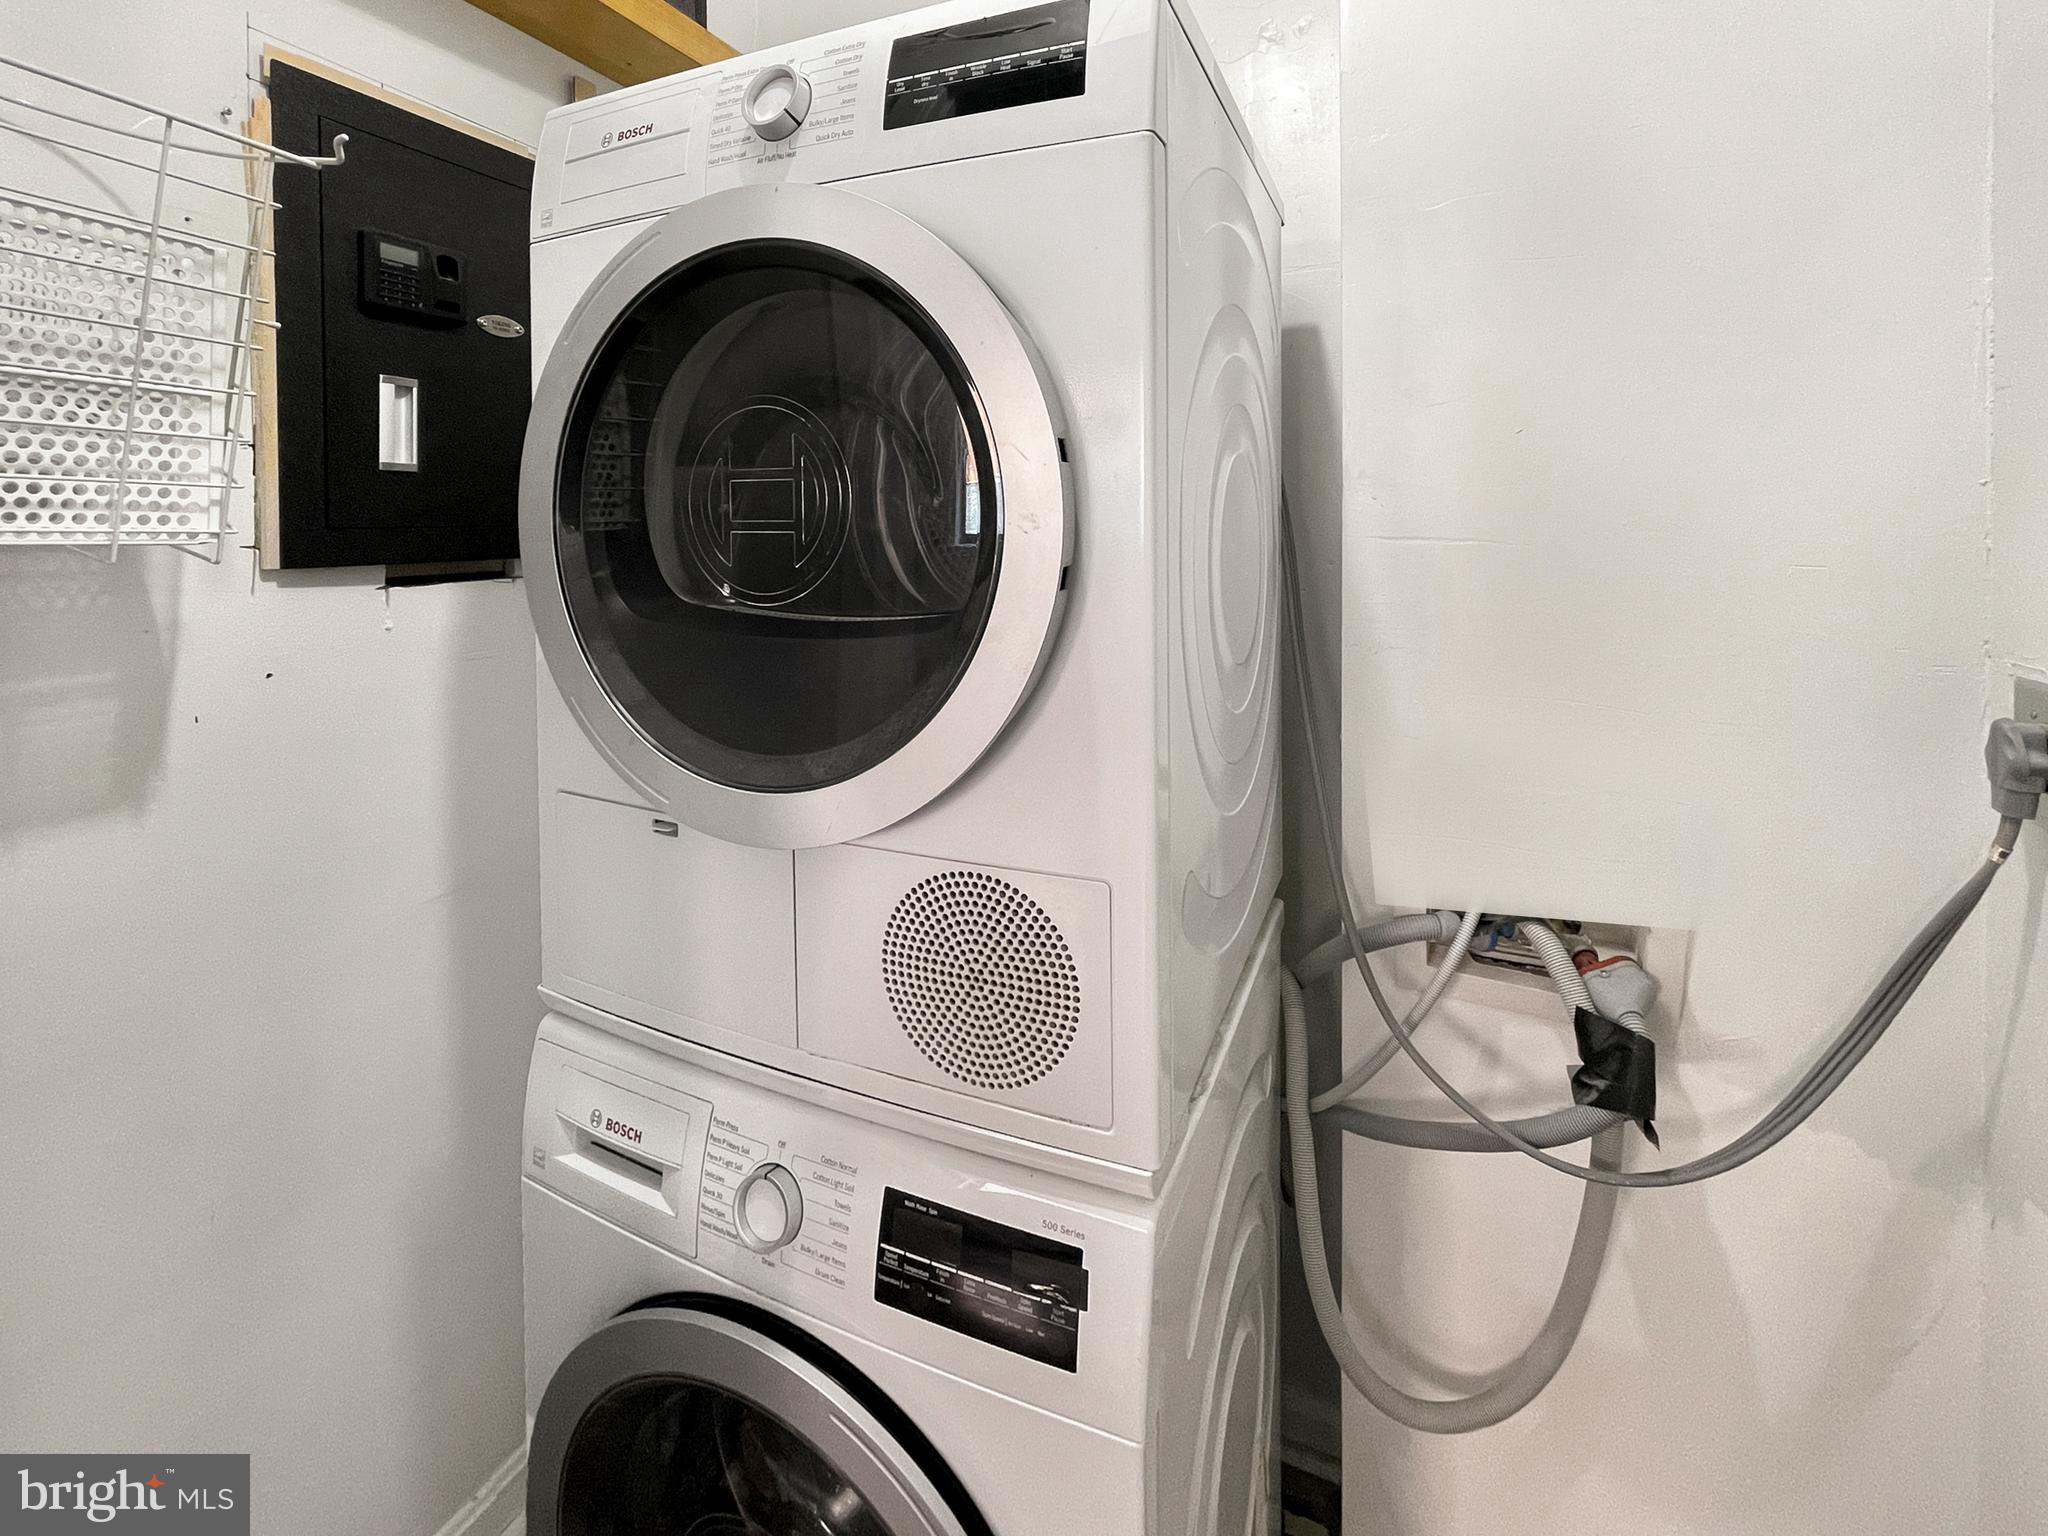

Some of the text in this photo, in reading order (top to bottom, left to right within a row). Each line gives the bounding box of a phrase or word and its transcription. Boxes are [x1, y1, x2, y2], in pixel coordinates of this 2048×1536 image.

[824, 48, 841, 56] Cotton
[834, 57, 852, 65] Cotton
[843, 68, 860, 76] Towels
[837, 82, 858, 91] Sanitize
[840, 97, 856, 105] Jeans
[617, 123, 654, 142] BOSCH
[815, 133, 830, 142] Quick
[713, 1116, 739, 1132] Perm Press
[605, 1118, 642, 1144] BOSCH
[741, 1146, 750, 1155] Soil
[777, 1140, 786, 1149] Off
[723, 1158, 734, 1168] Light
[734, 1163, 743, 1172] Soil
[820, 1155, 858, 1174] Cotton Normal
[705, 1169, 725, 1183] Delicates
[813, 1171, 855, 1192] Cotton Light Soil
[702, 1186, 715, 1197] Quick
[834, 1199, 851, 1212] Towels
[829, 1217, 849, 1231] Sanitize
[1042, 1219, 1085, 1240] 500 Series
[832, 1239, 847, 1250] Jeans
[831, 1256, 846, 1268] Items
[815, 1268, 846, 1286] Drum Clean
